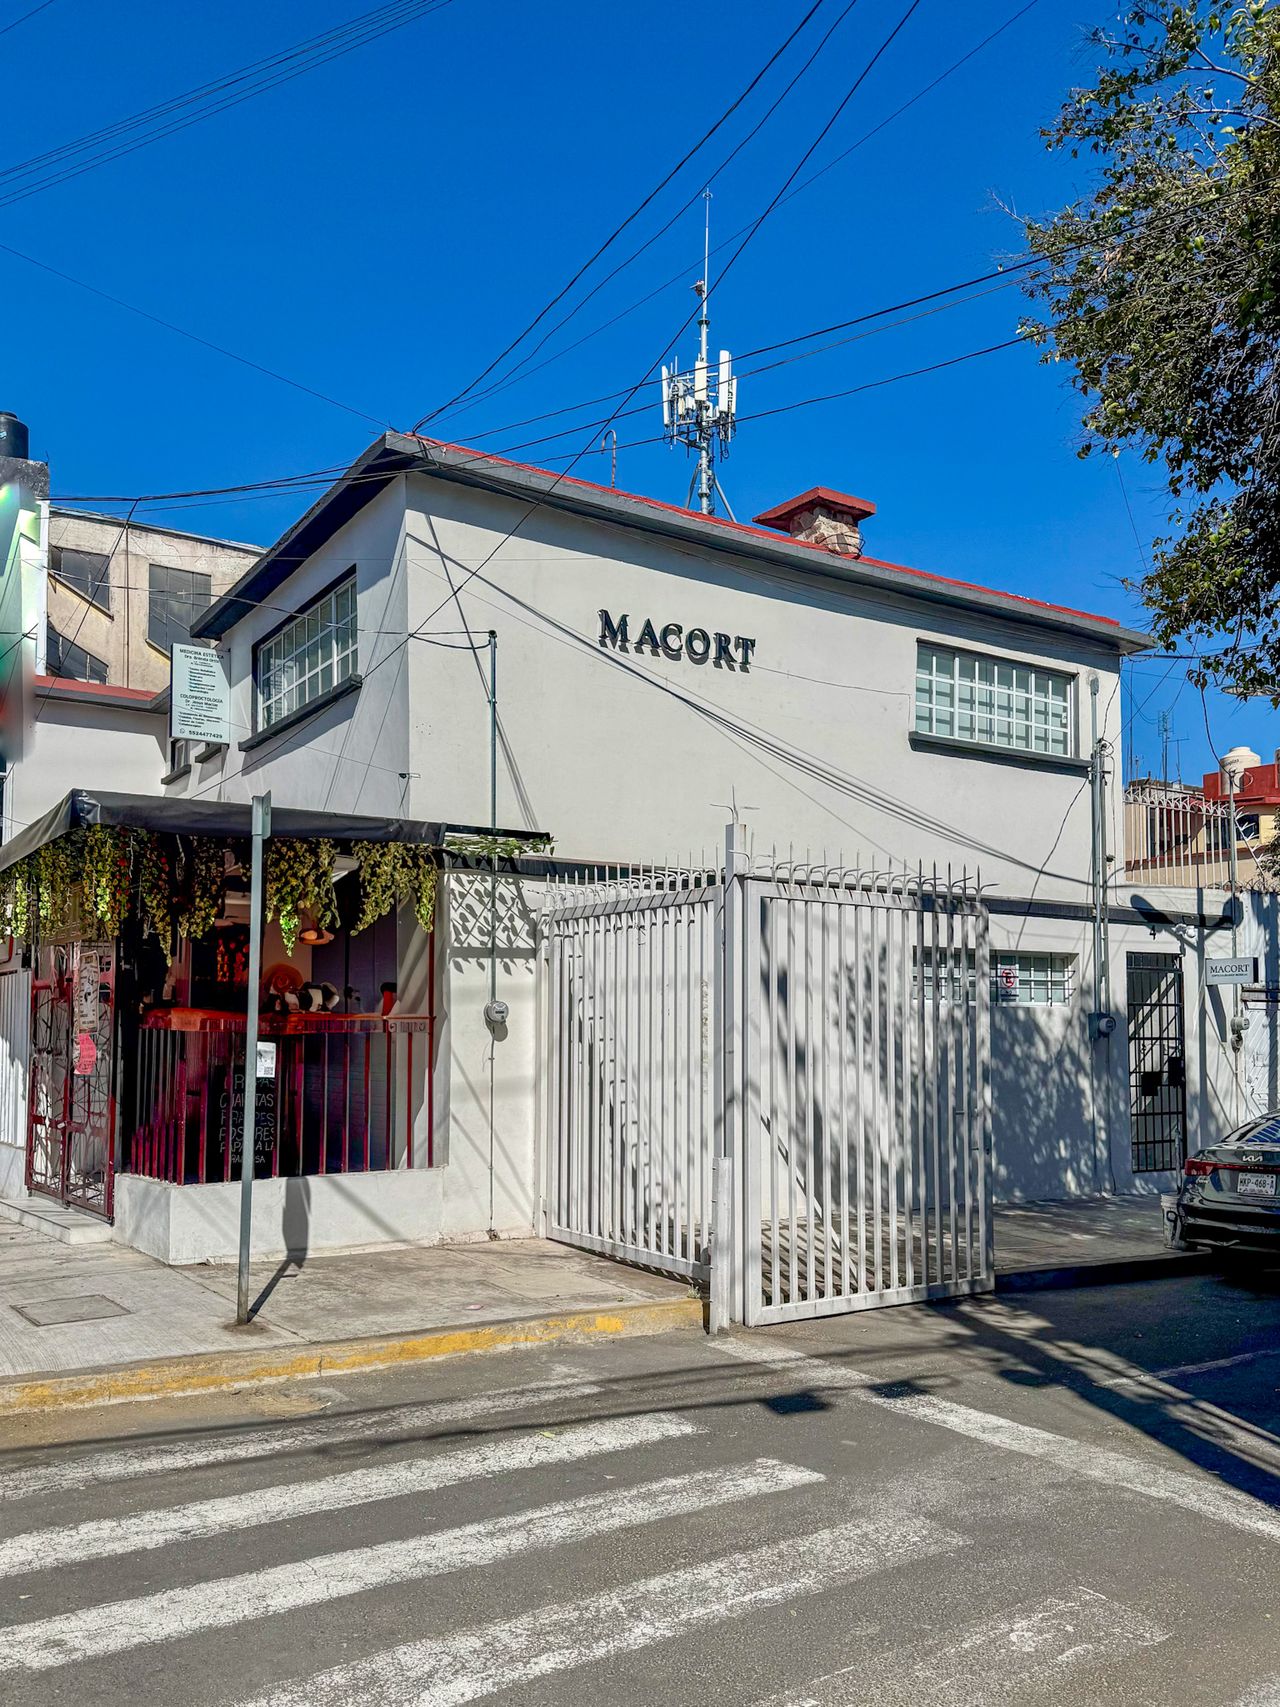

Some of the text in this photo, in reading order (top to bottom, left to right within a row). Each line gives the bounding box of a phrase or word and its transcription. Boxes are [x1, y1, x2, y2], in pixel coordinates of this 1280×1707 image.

[597, 609, 756, 666] MACORT
[1149, 924, 1156, 940] 4
[1210, 964, 1250, 974] MACORT
